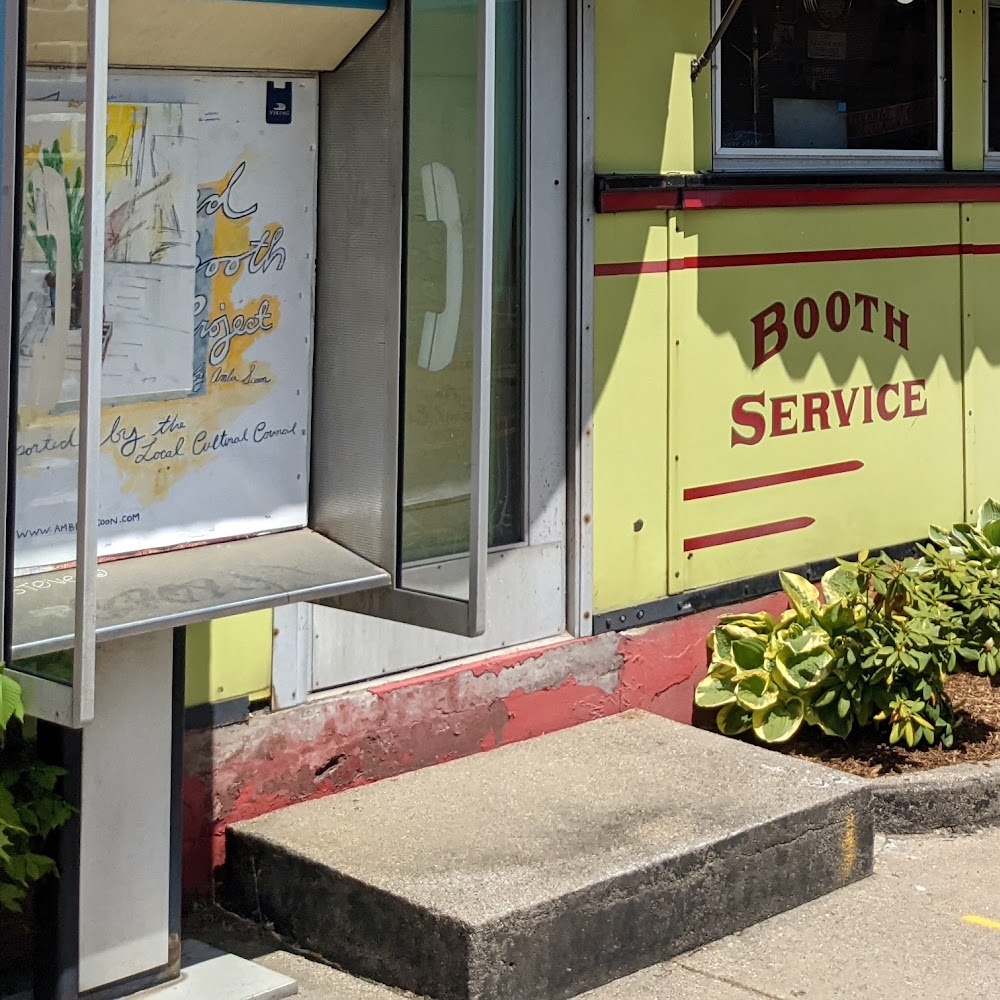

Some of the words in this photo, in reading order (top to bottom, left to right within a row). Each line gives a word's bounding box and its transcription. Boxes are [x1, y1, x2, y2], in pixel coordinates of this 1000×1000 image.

[750, 290, 910, 370] BOOTH
[99, 415, 146, 458] by
[151, 414, 186, 437] the
[731, 378, 928, 448] SERVICE
[135, 437, 185, 464] Local
[192, 430, 249, 456] Cultural
